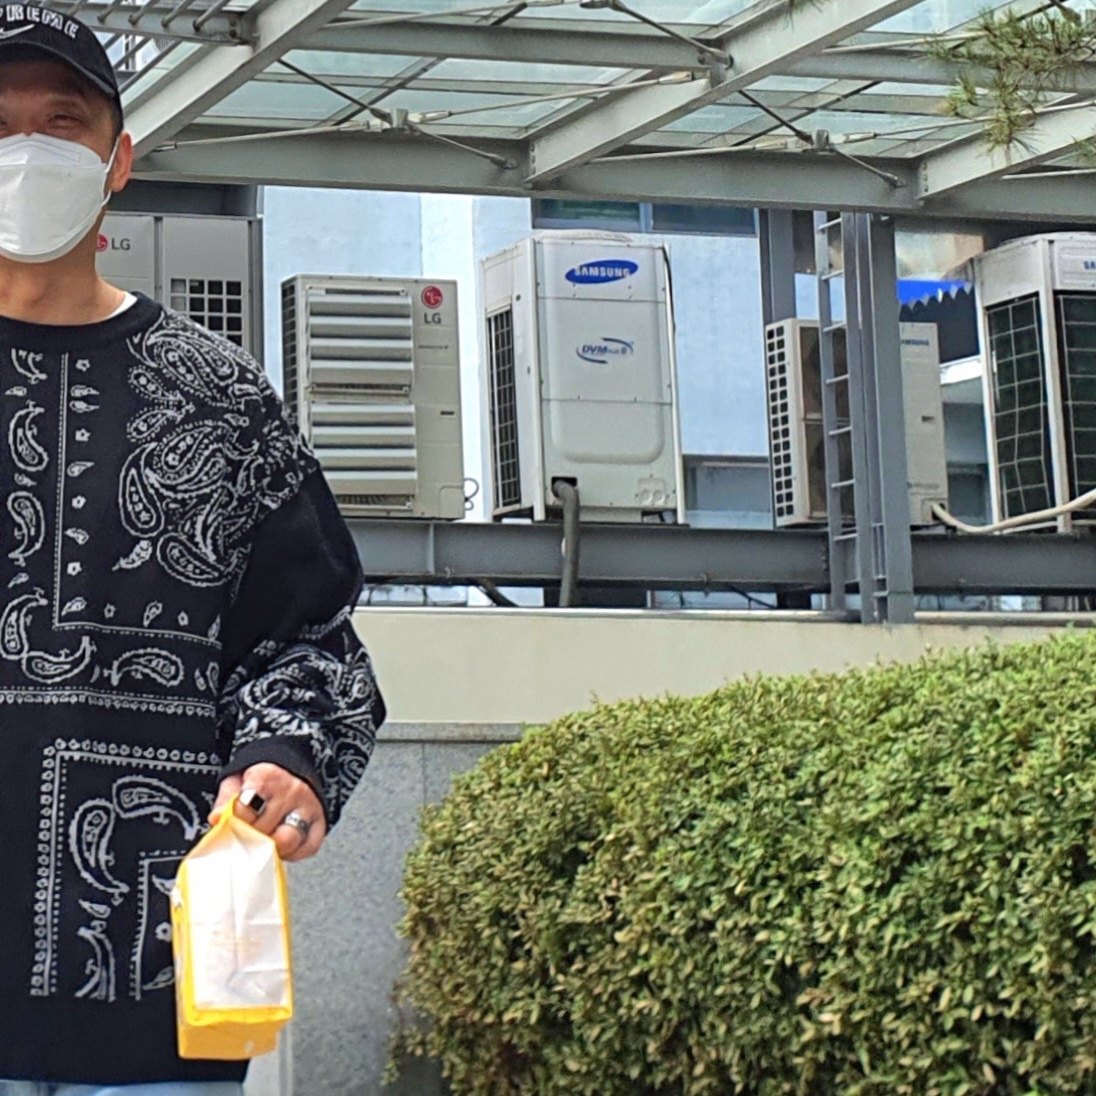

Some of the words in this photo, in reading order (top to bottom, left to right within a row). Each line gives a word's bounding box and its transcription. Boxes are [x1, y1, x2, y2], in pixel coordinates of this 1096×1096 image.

[111, 237, 131, 251] LG
[574, 265, 631, 279] SAMSUNG
[423, 312, 442, 325] LG
